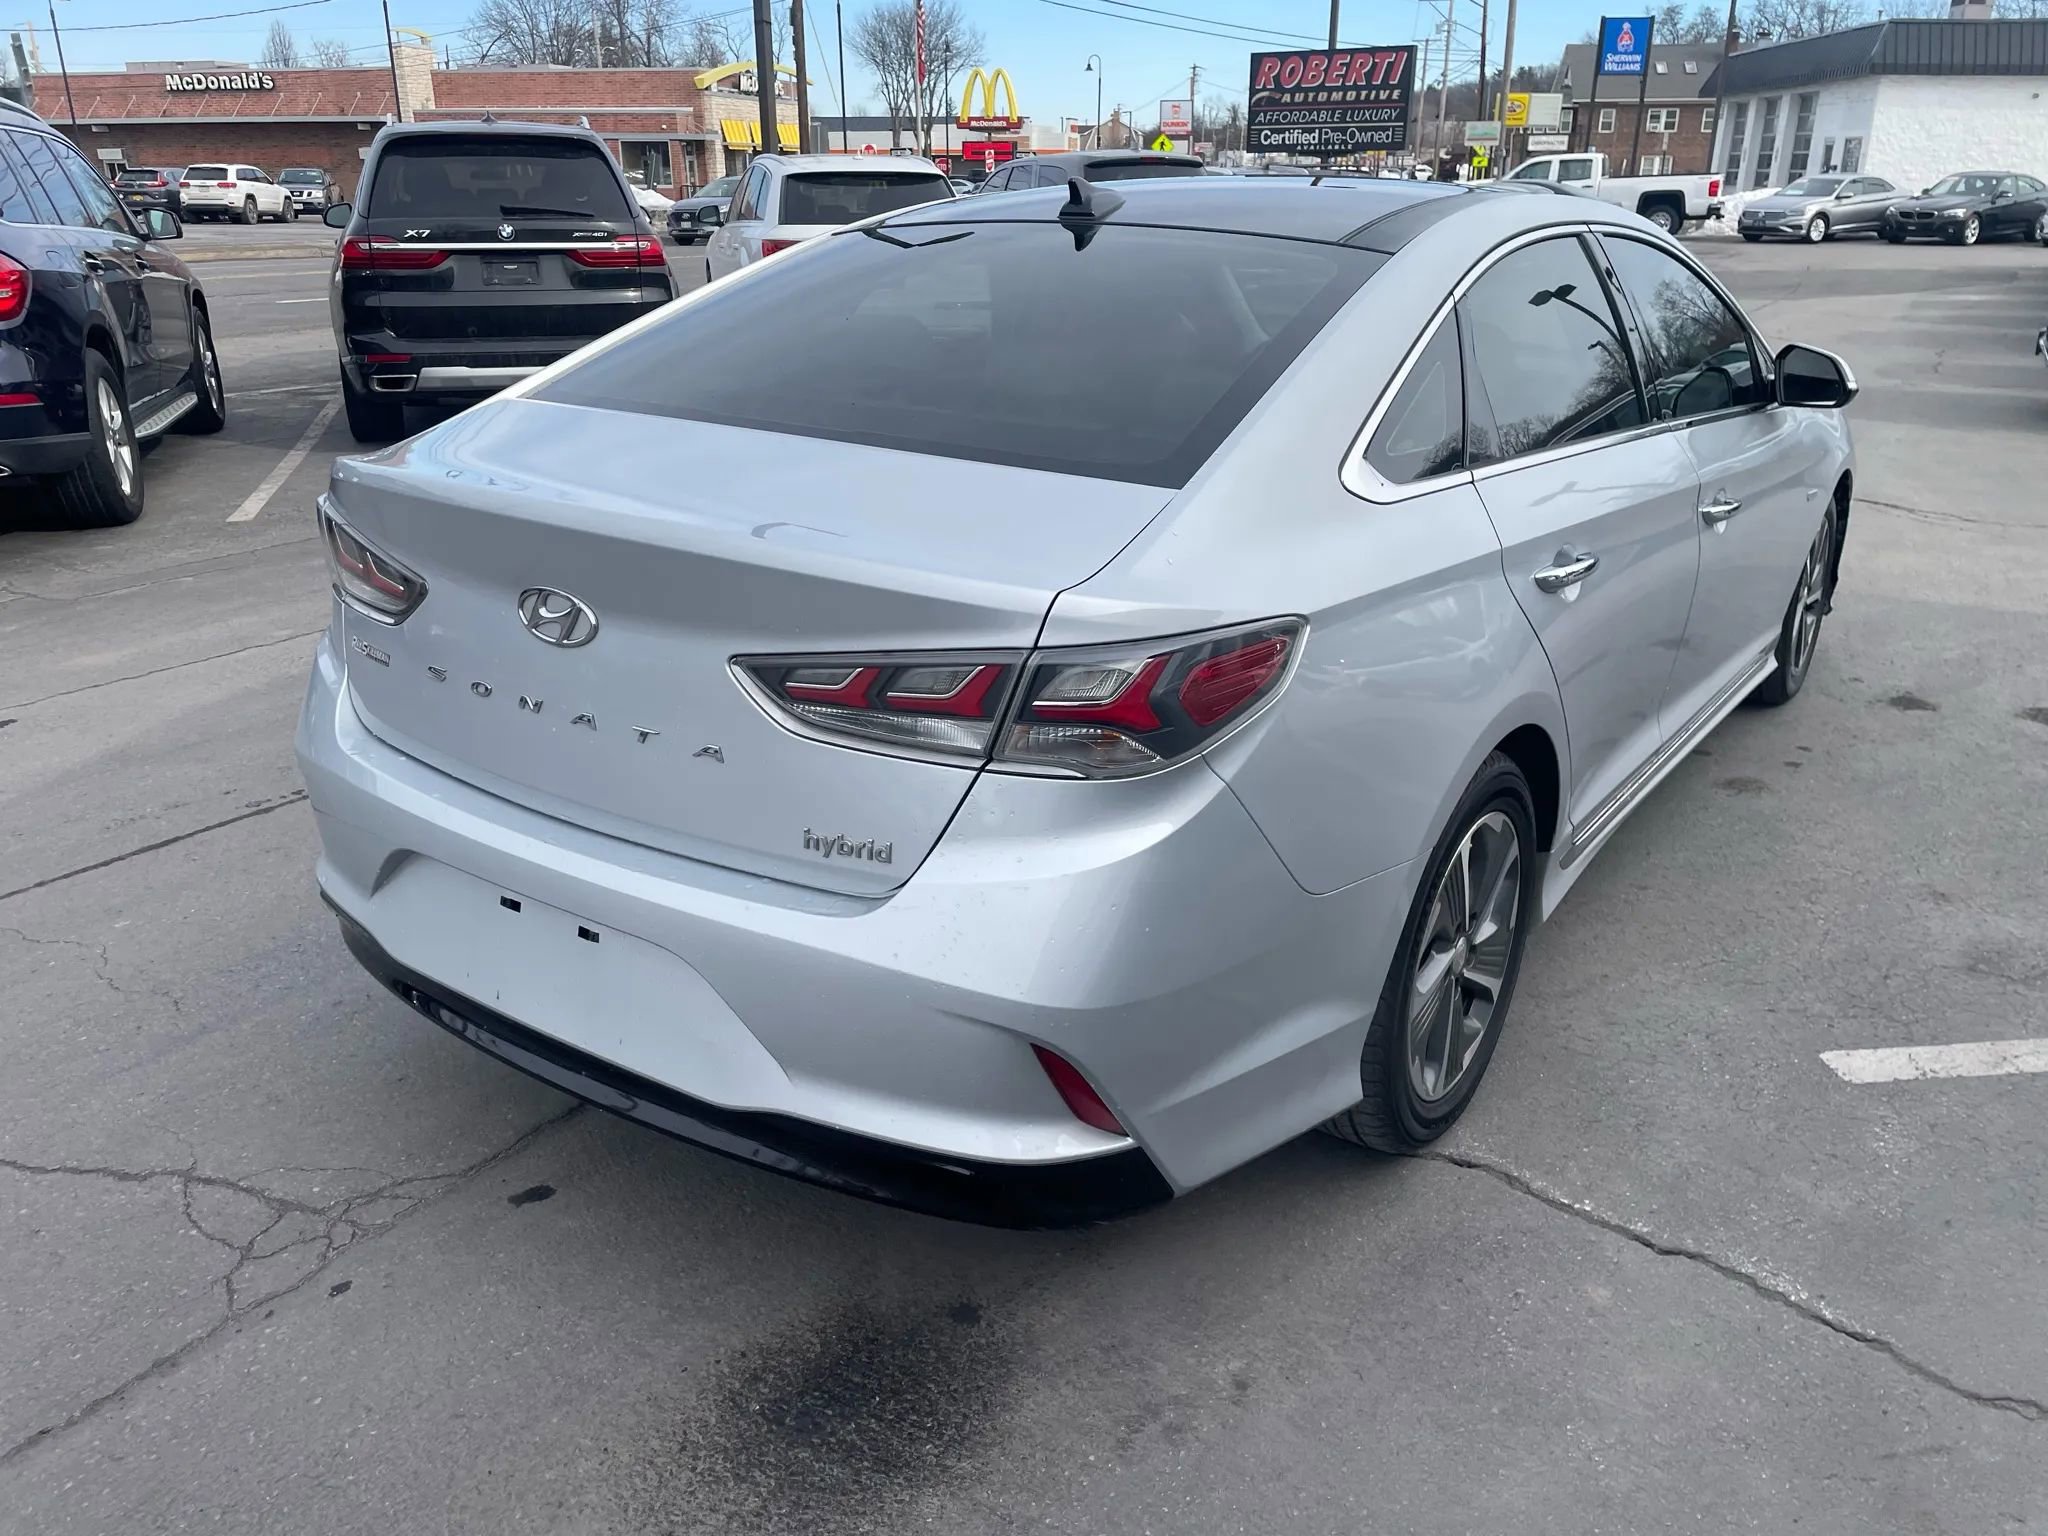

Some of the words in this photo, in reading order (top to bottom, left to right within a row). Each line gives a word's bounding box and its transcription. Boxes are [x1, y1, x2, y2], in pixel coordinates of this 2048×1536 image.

[1604, 61, 1641, 71] WILLIAMS
[1606, 53, 1642, 63] SHERWIN
[1255, 51, 1408, 89] ROBERTI
[165, 72, 274, 91] McDonald's
[1281, 89, 1402, 103] AUTOMOTIVE
[1255, 109, 1342, 123] AFFORDABLE
[1346, 108, 1400, 121] LUXURY
[1260, 129, 1319, 145] Certified
[1321, 127, 1392, 144] Pre-Owned
[404, 229, 431, 238] X7
[426, 665, 725, 763] SONATA
[803, 827, 893, 864] hybrid
